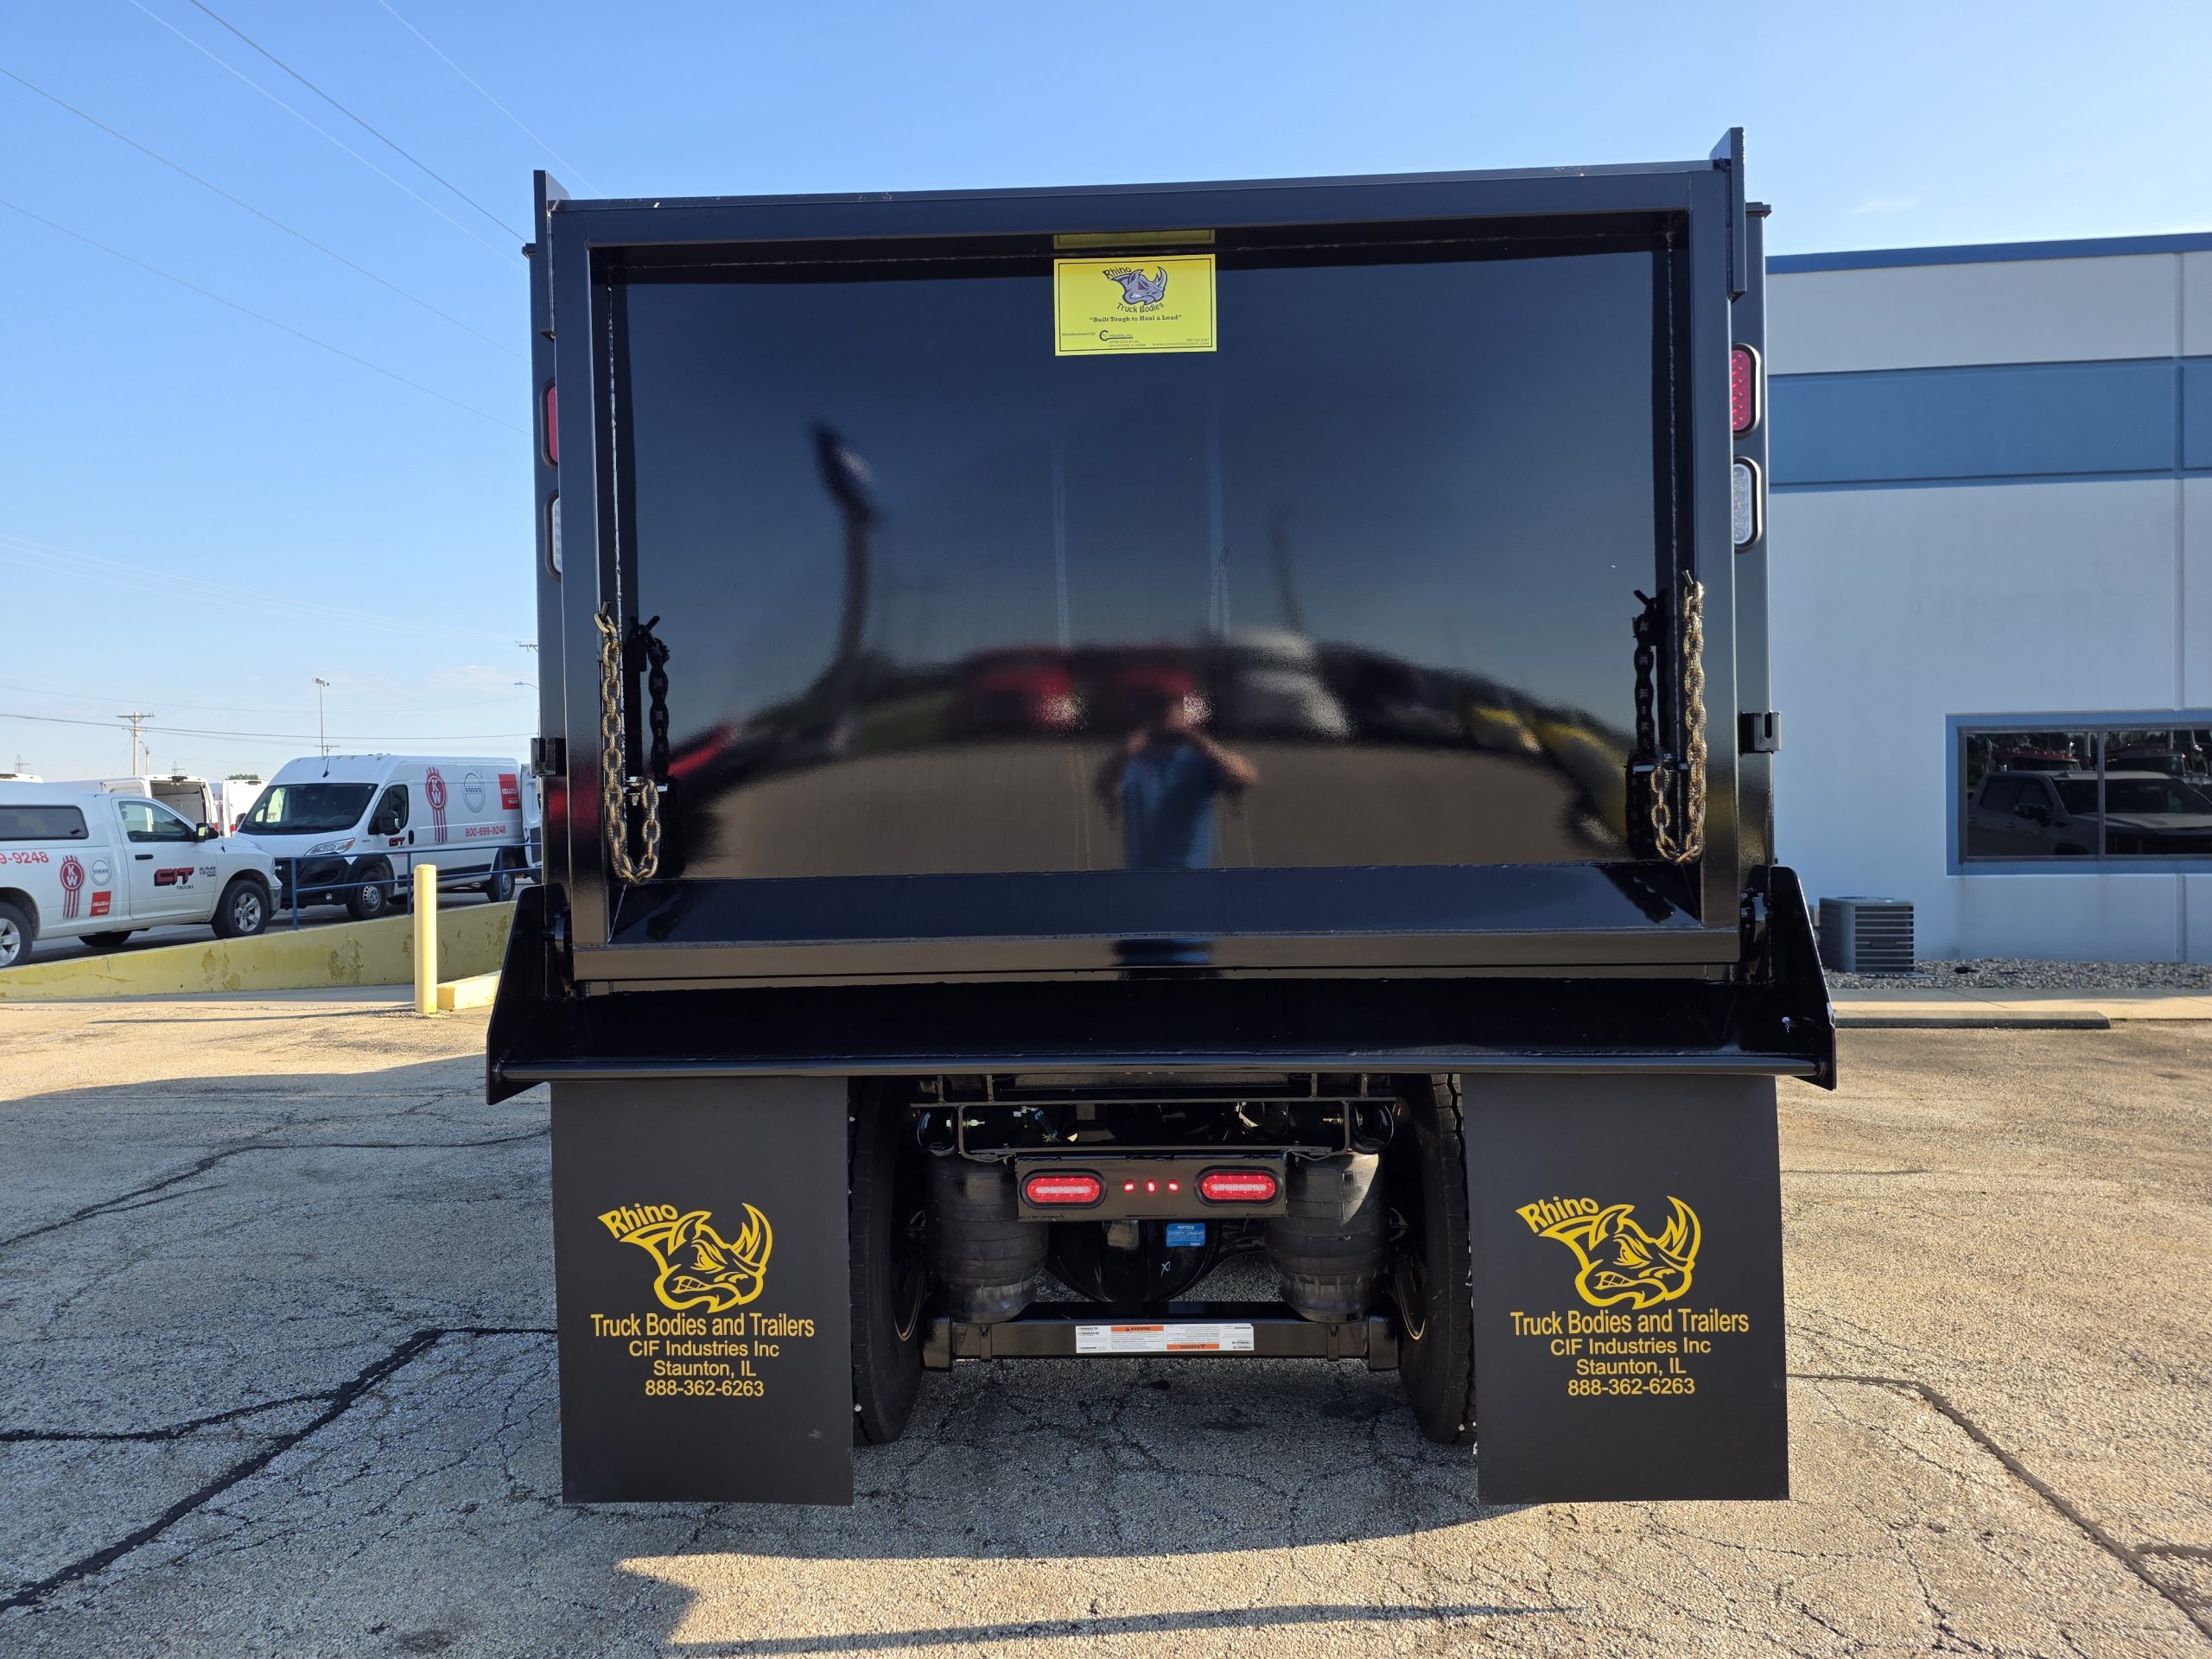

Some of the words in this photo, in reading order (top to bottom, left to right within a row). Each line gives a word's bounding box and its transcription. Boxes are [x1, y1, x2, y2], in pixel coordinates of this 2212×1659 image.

[1103, 266, 1132, 279] Rhino
[1116, 302, 1138, 313] Truck
[1140, 302, 1164, 313] Bodies
[465, 825, 506, 837] 800-699-9248
[0, 851, 49, 864] 9-9248
[597, 1203, 678, 1238] Rhino
[1516, 1196, 1599, 1233] Rhino
[590, 1313, 641, 1337] Truck
[646, 1313, 707, 1336] Bodies
[712, 1313, 745, 1336] and
[749, 1313, 815, 1337] Trailers
[1510, 1311, 1562, 1335] Truck
[1568, 1310, 1631, 1334] Bodies
[1637, 1308, 1673, 1332] and
[1678, 1308, 1749, 1332] Trailers
[629, 1340, 660, 1357] CIF
[665, 1340, 748, 1357] Industries
[754, 1341, 779, 1357] Inc
[1550, 1338, 1582, 1356] CIF
[1589, 1338, 1677, 1354] Industries
[1683, 1337, 1711, 1354] Inc
[653, 1359, 735, 1378] Staunton,
[741, 1360, 757, 1376] IL
[1576, 1358, 1663, 1376] Staunton,
[1669, 1357, 1687, 1374] IL
[645, 1380, 765, 1396] 888-362-6263
[1567, 1377, 1695, 1396] 888-362-6263
